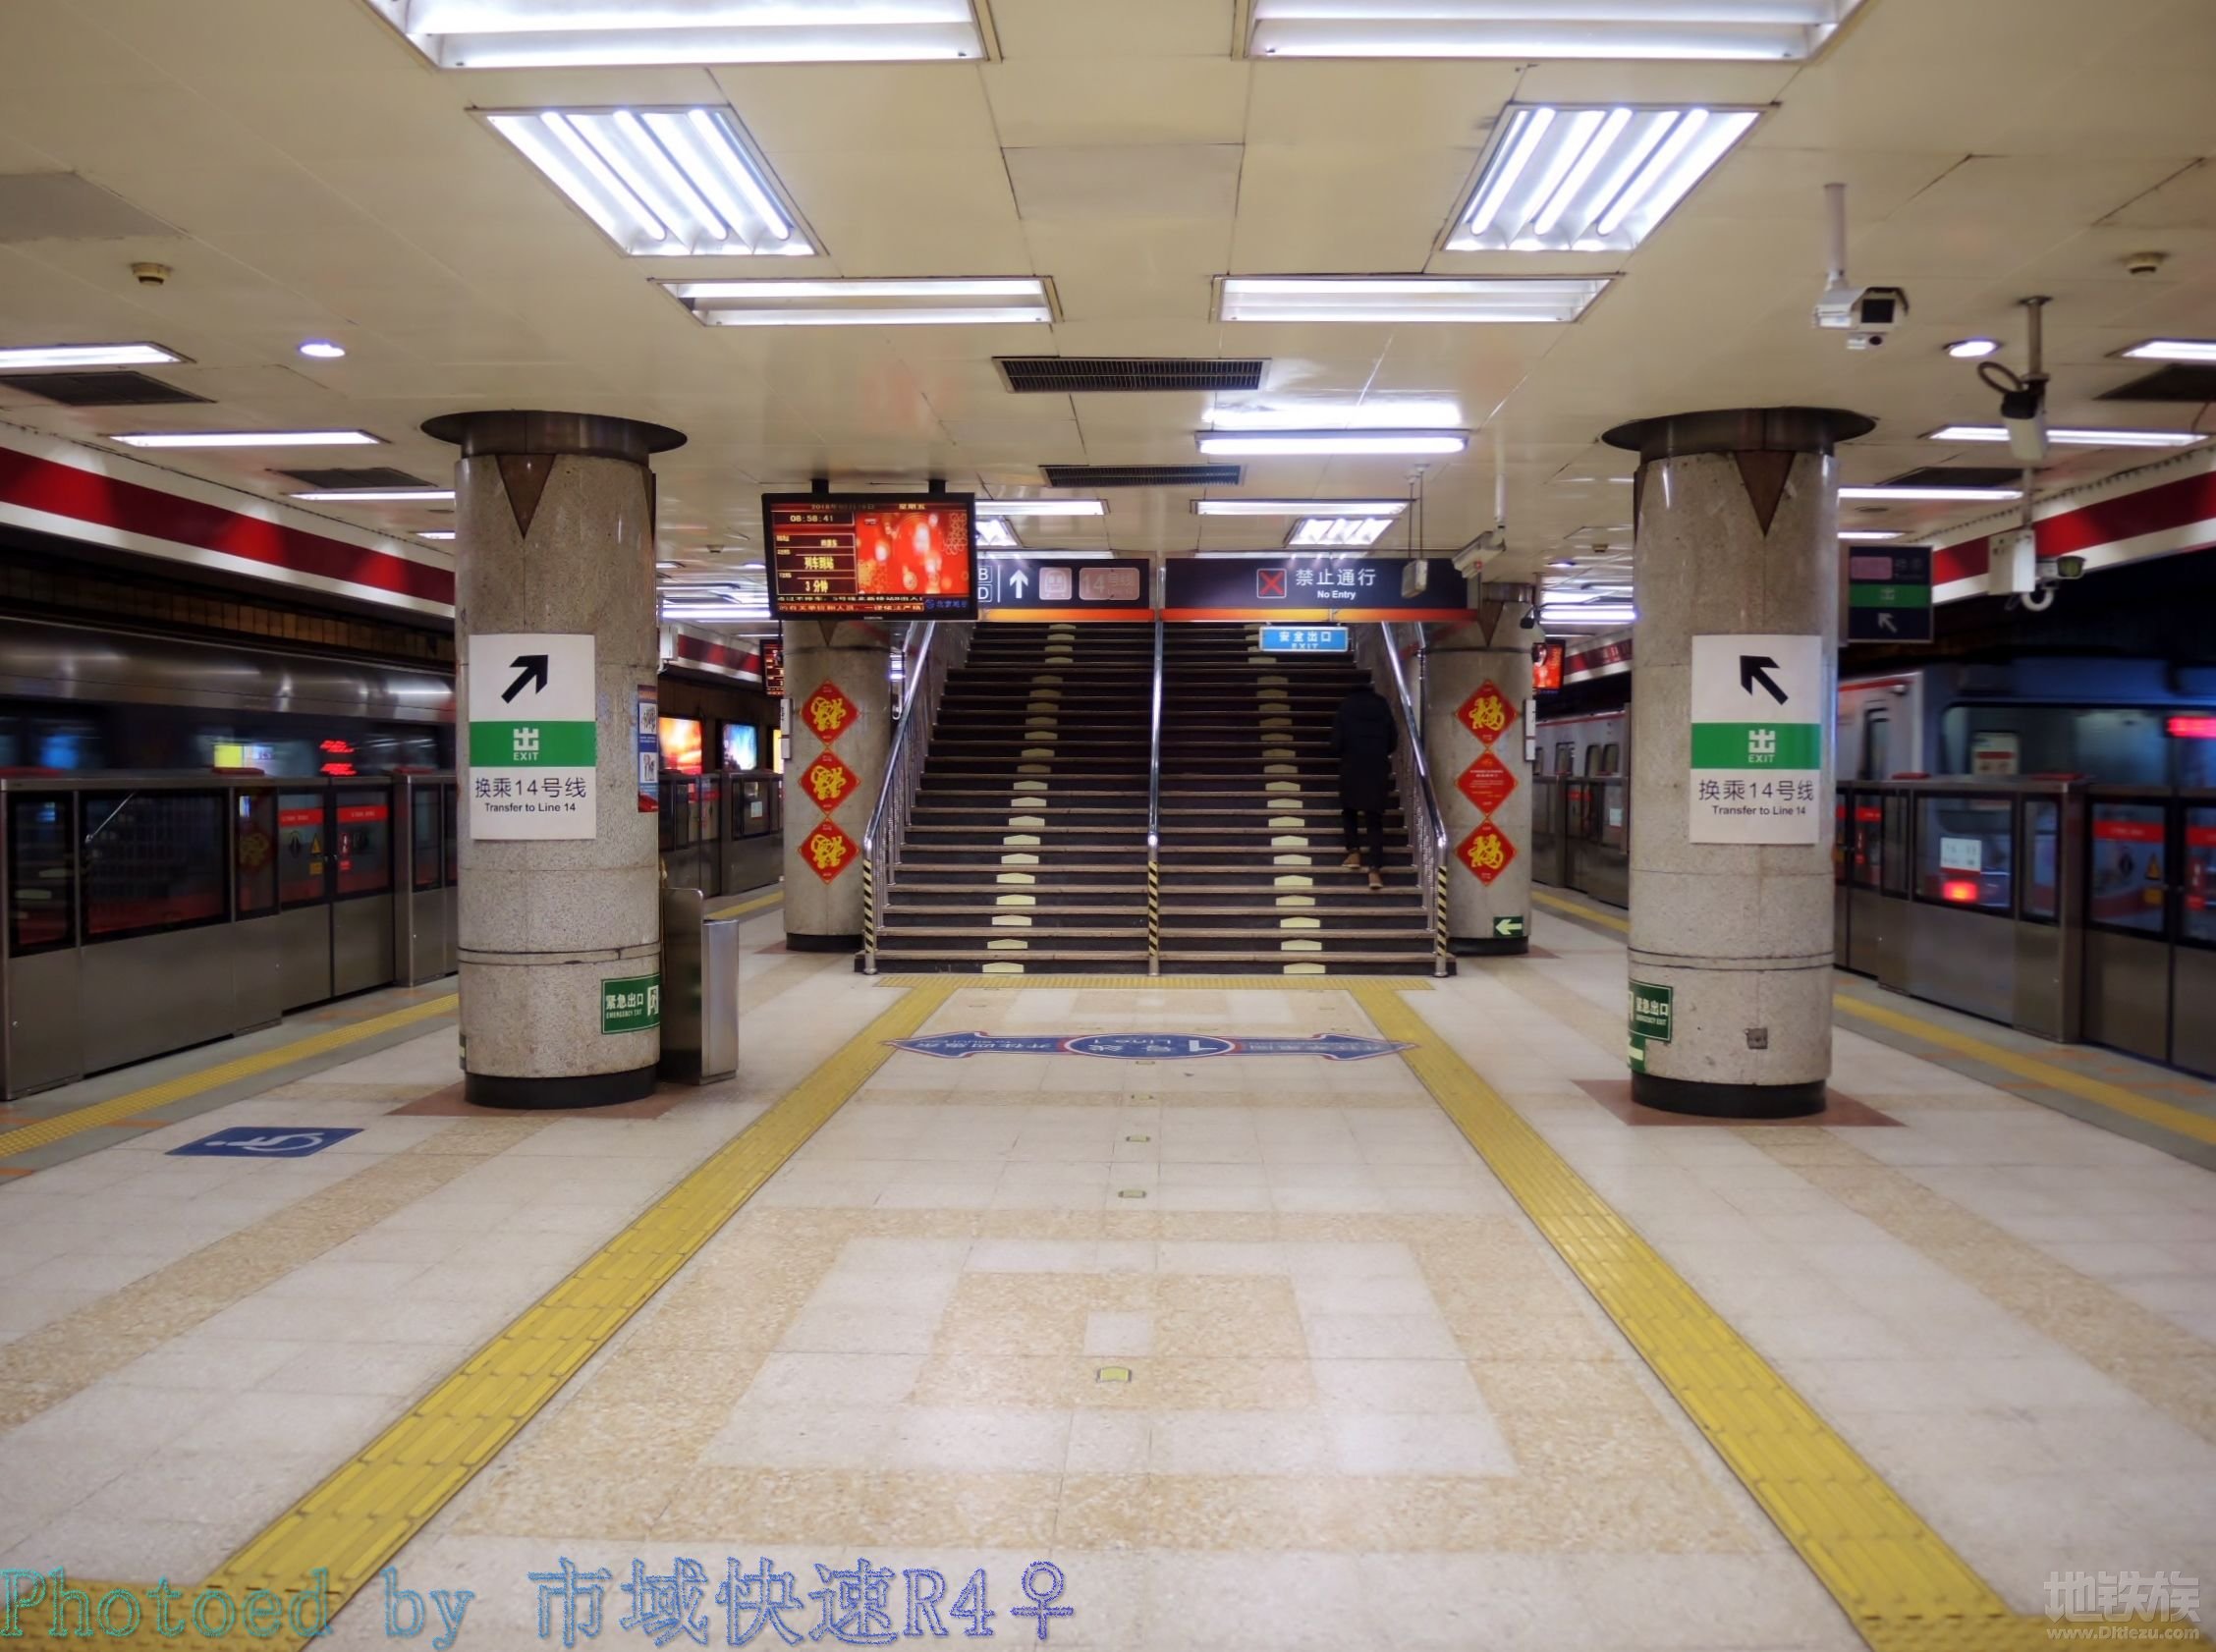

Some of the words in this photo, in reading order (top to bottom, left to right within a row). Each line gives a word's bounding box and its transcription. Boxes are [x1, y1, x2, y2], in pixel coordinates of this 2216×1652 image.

[1296, 568, 1376, 586] 禁止通行
[1317, 590, 1330, 599] No
[1332, 590, 1357, 600] Entry
[1279, 631, 1332, 642] 安全出口
[513, 752, 539, 761] EXIT
[1748, 754, 1776, 763] EXIT
[474, 777, 587, 798] 换乘14号线
[1698, 779, 1814, 801] 换乘14号线
[485, 802, 523, 812] Transfer
[525, 803, 535, 812] to
[538, 802, 560, 812] Line
[564, 802, 576, 812] 14
[1712, 805, 1757, 816] Transfer
[1759, 806, 1770, 816] to
[1773, 806, 1793, 816] Line
[1797, 806, 1806, 816] 14
[605, 992, 644, 1010] 紧急出口
